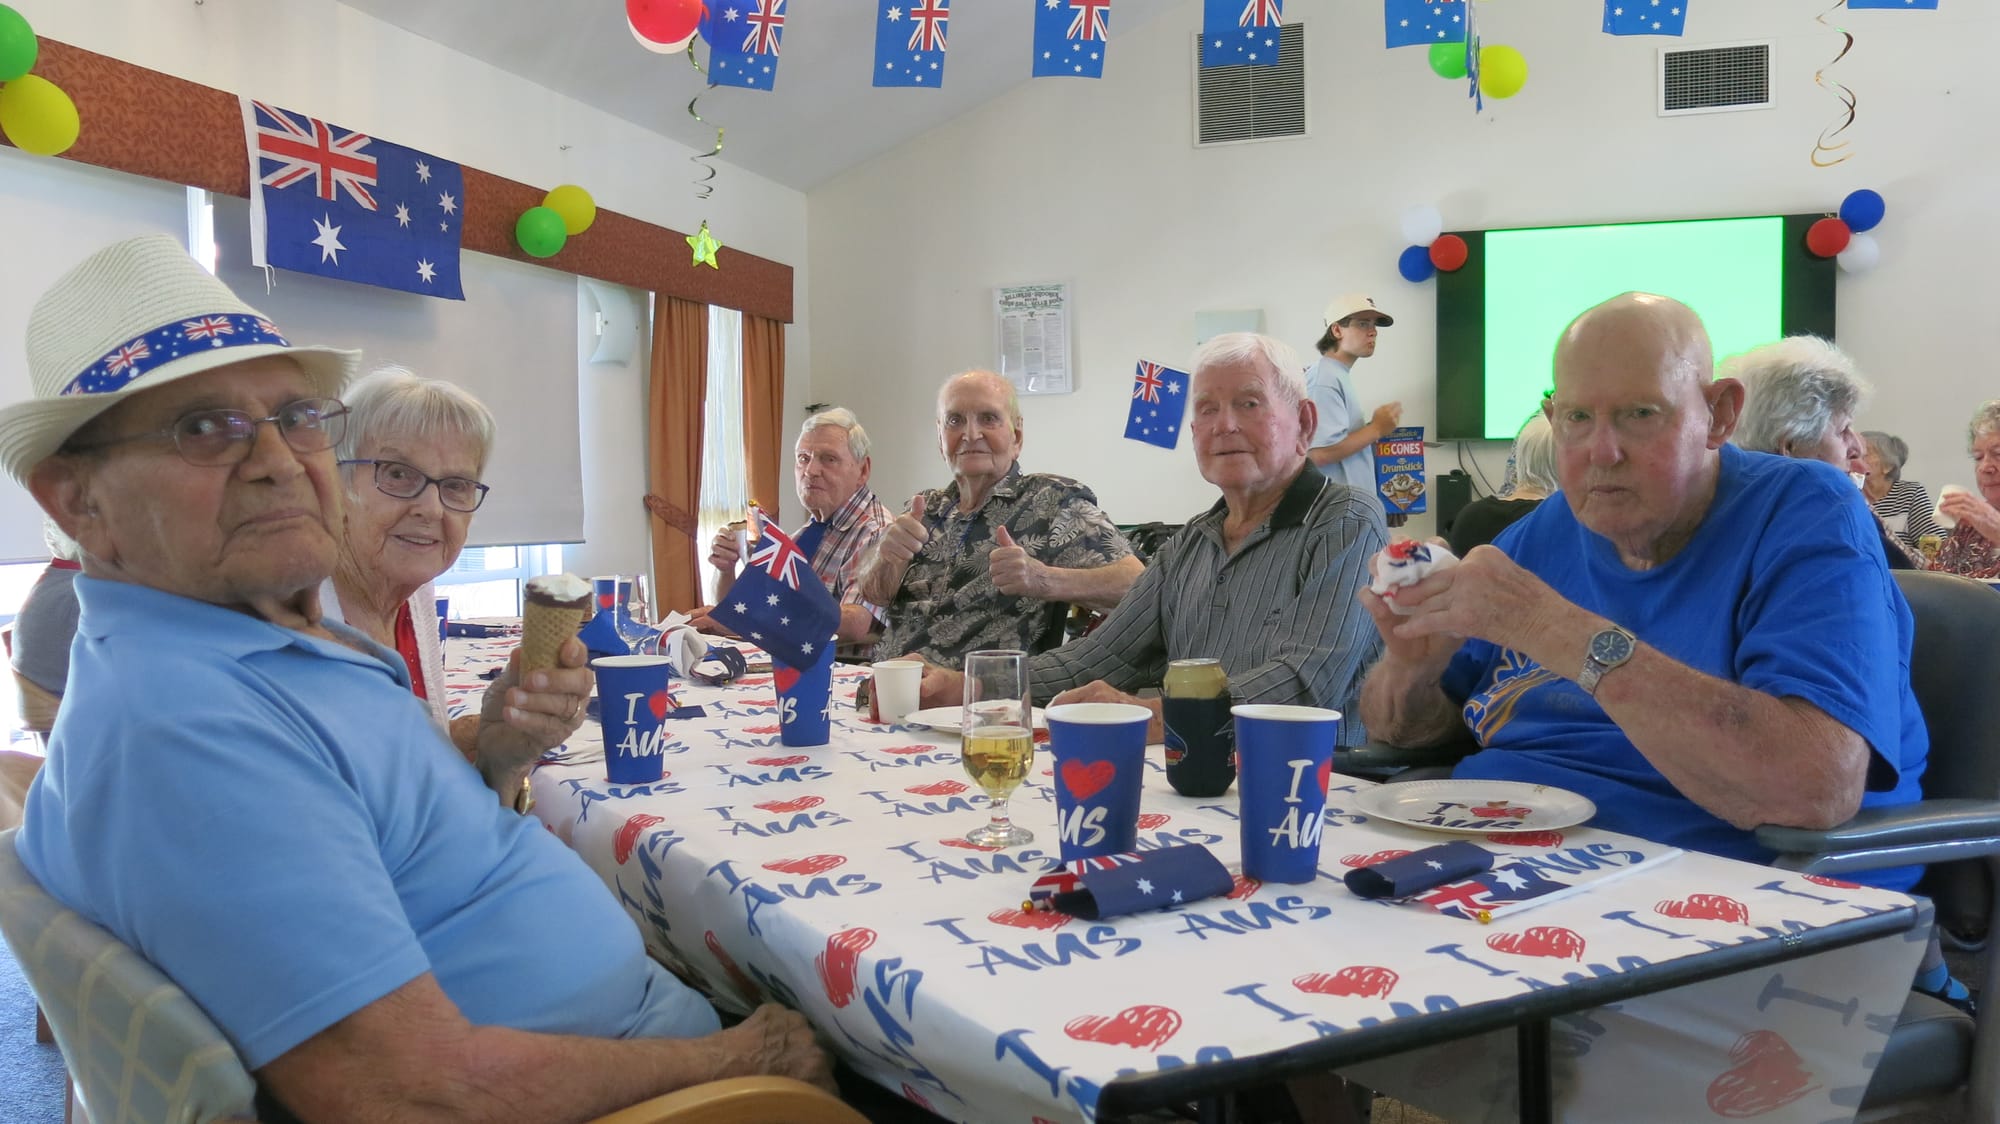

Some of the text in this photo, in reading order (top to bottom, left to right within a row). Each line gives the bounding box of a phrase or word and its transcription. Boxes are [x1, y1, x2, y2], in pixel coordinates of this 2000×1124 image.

[1381, 461, 1424, 474] Drumstick
[1391, 443, 1421, 456] CONES
[624, 692, 645, 725] I
[1284, 758, 1315, 803] I
[1059, 804, 1109, 847] US
[1268, 803, 1326, 849] AU
